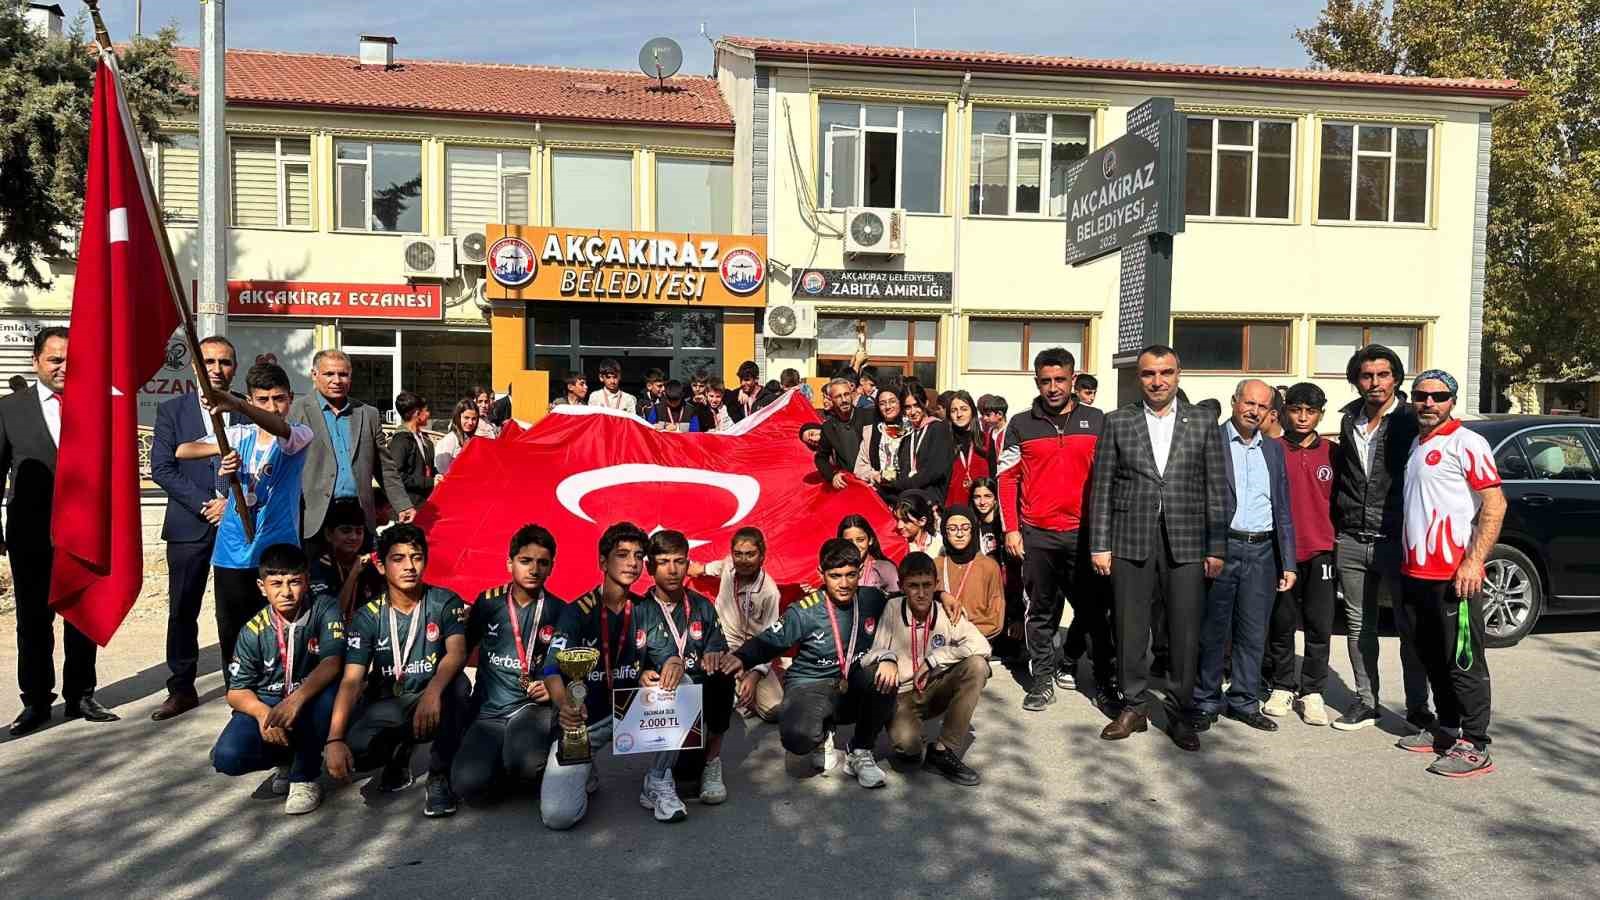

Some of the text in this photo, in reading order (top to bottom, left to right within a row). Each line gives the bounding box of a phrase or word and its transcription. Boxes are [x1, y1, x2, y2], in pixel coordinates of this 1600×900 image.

[831, 283, 880, 296] ZABITA
[349, 290, 432, 308] ECZANESİ
[639, 717, 680, 728] 2.000 TL
